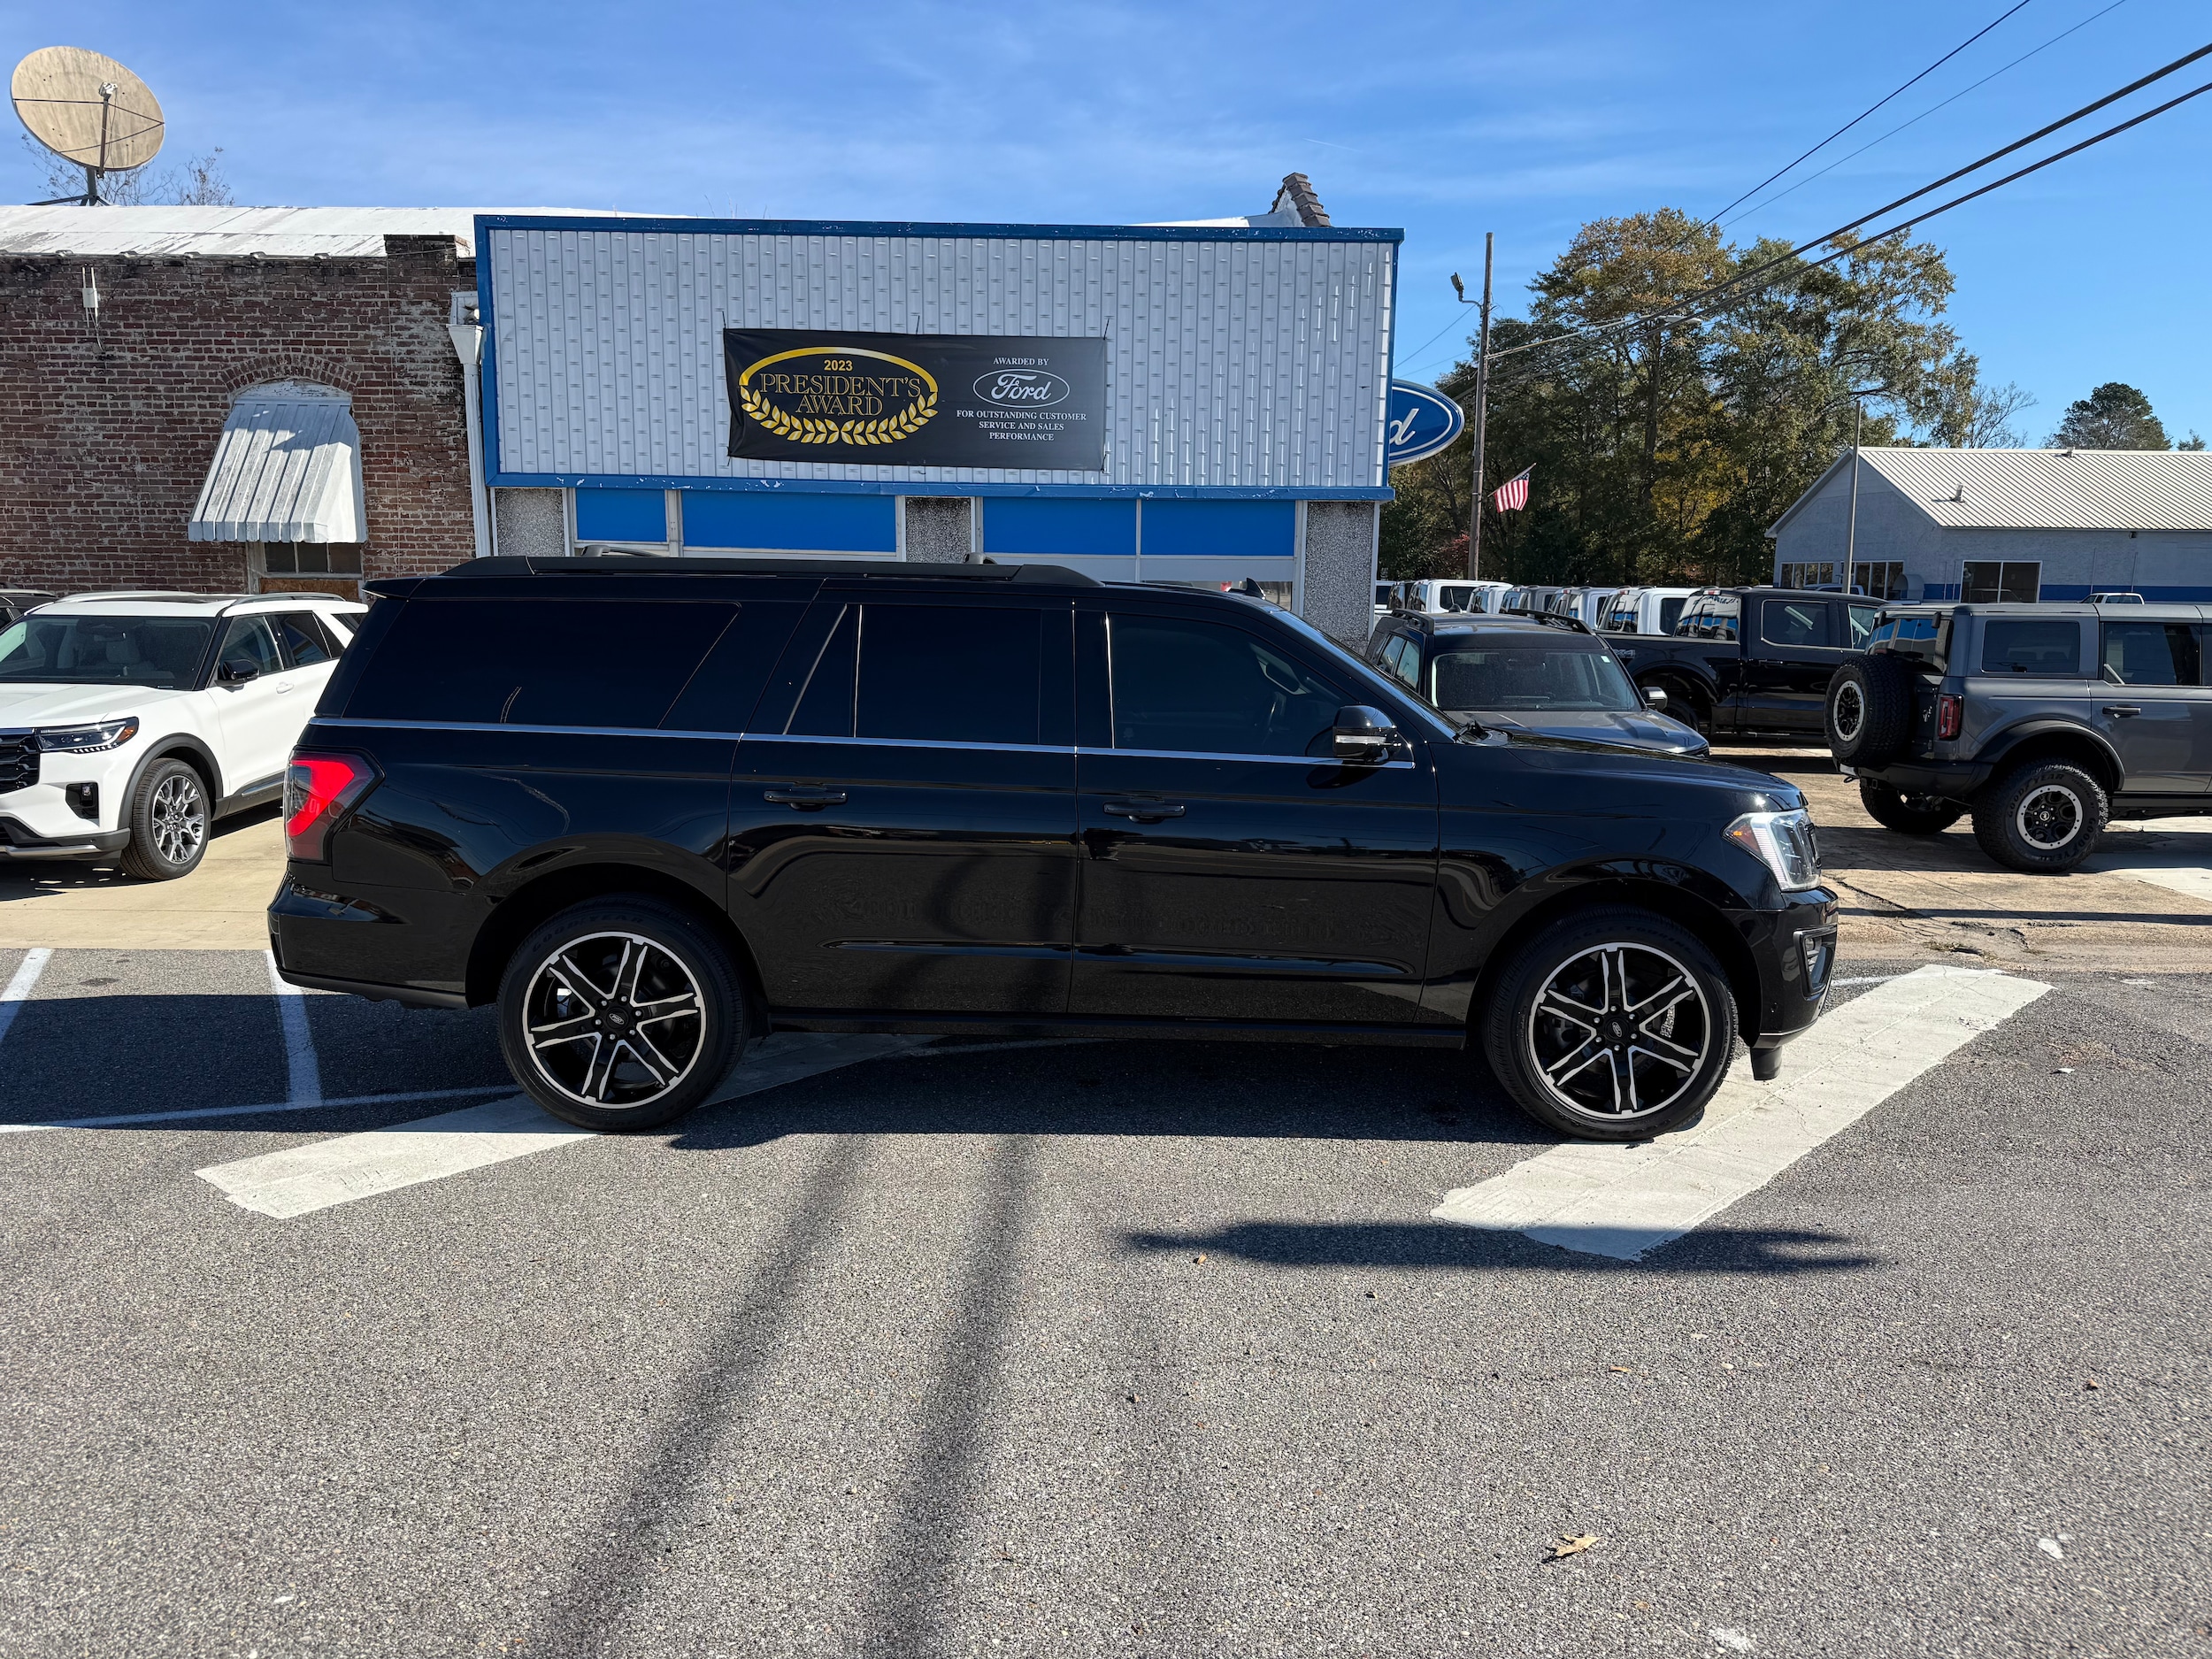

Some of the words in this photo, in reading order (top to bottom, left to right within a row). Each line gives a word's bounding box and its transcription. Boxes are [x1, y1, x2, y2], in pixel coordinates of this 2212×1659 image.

[824, 359, 853, 372] 2023
[759, 373, 921, 397] PRESIDENT'S
[990, 373, 1052, 400] Ford
[795, 395, 883, 416] AWARD
[976, 411, 1037, 419] OUTSTANDING
[979, 421, 1016, 430] SERVICE
[989, 432, 1055, 442] PERFORMANCE
[2008, 772, 2065, 818] GOODYEAR
